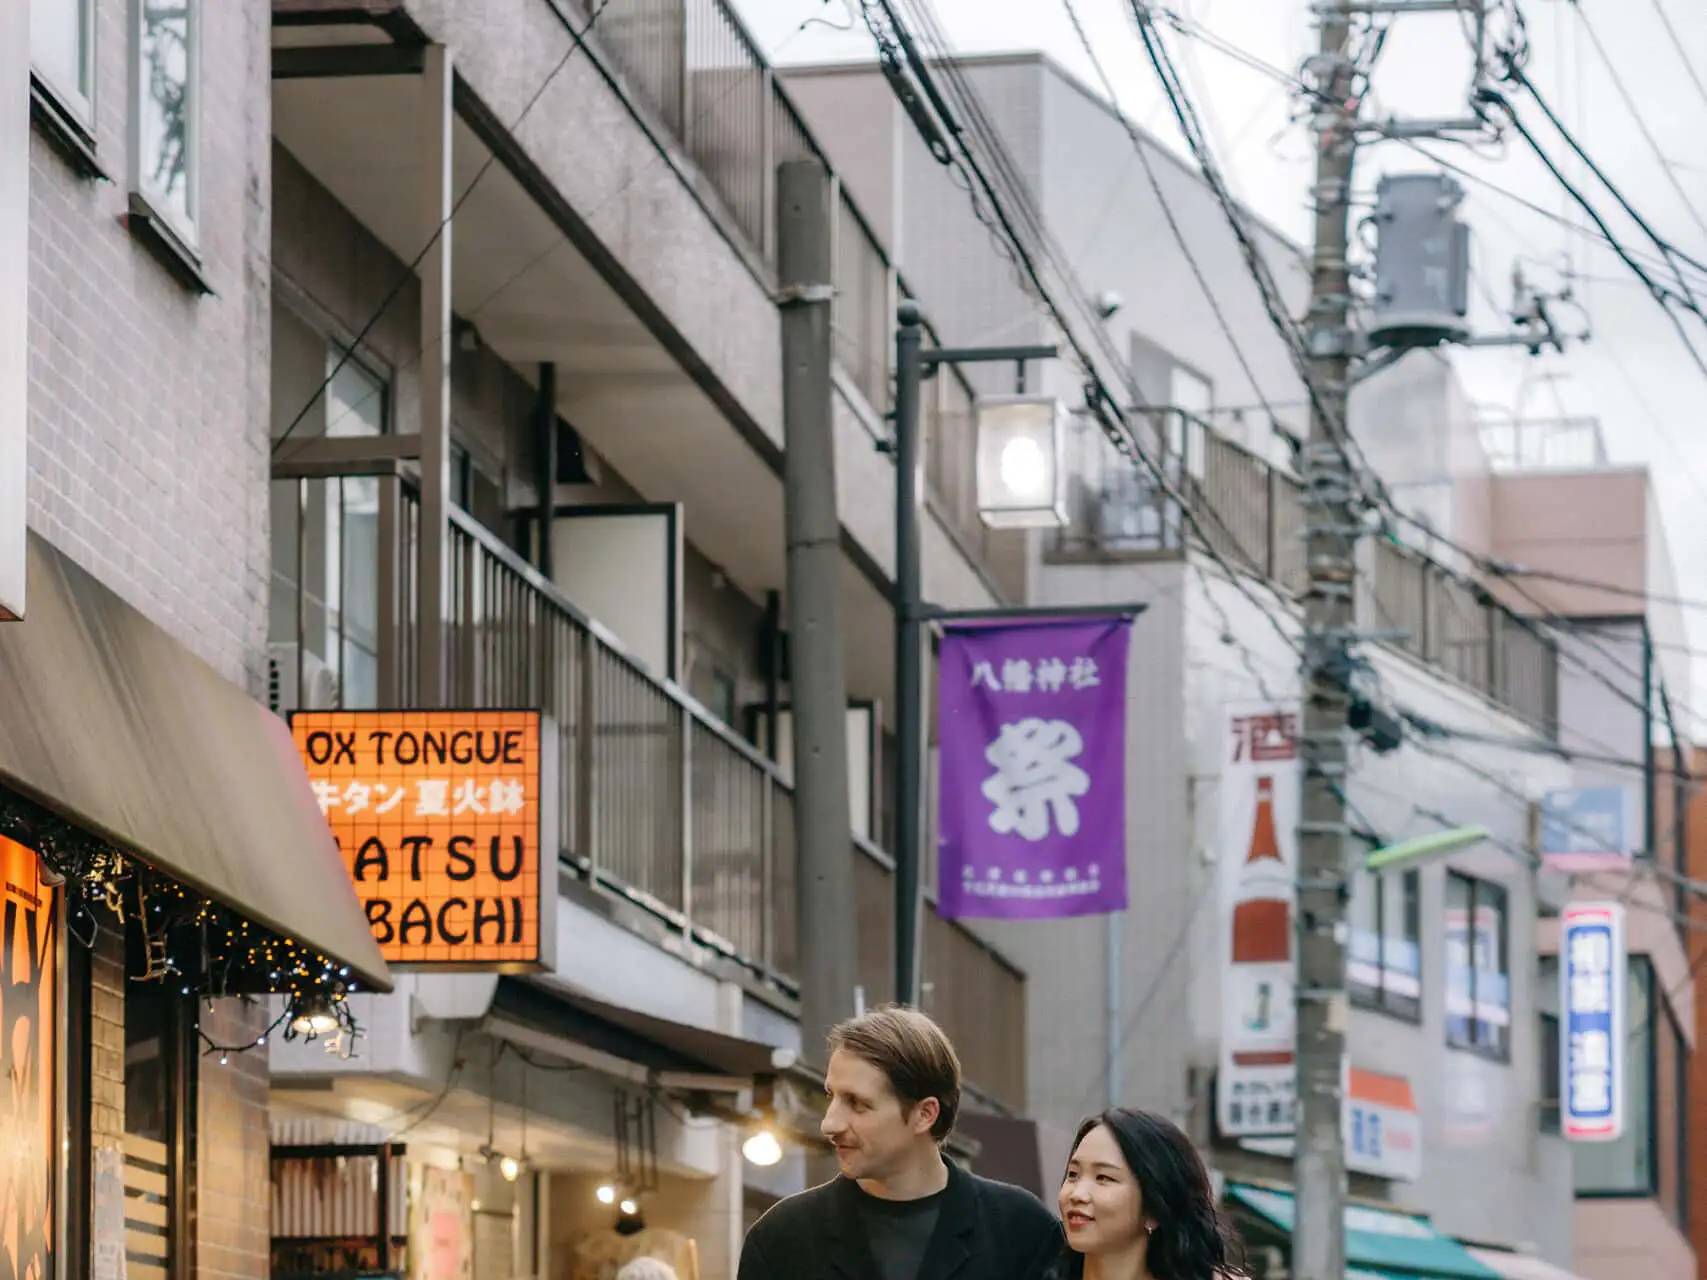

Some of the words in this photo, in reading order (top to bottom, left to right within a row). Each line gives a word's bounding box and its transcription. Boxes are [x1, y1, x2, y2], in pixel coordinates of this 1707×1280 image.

[306, 731, 356, 765] OX
[369, 730, 524, 765] TONGUE
[1231, 713, 1297, 764] 酒
[981, 717, 1091, 842] 祭
[333, 835, 524, 881] ATSU
[365, 897, 523, 944] BACHI
